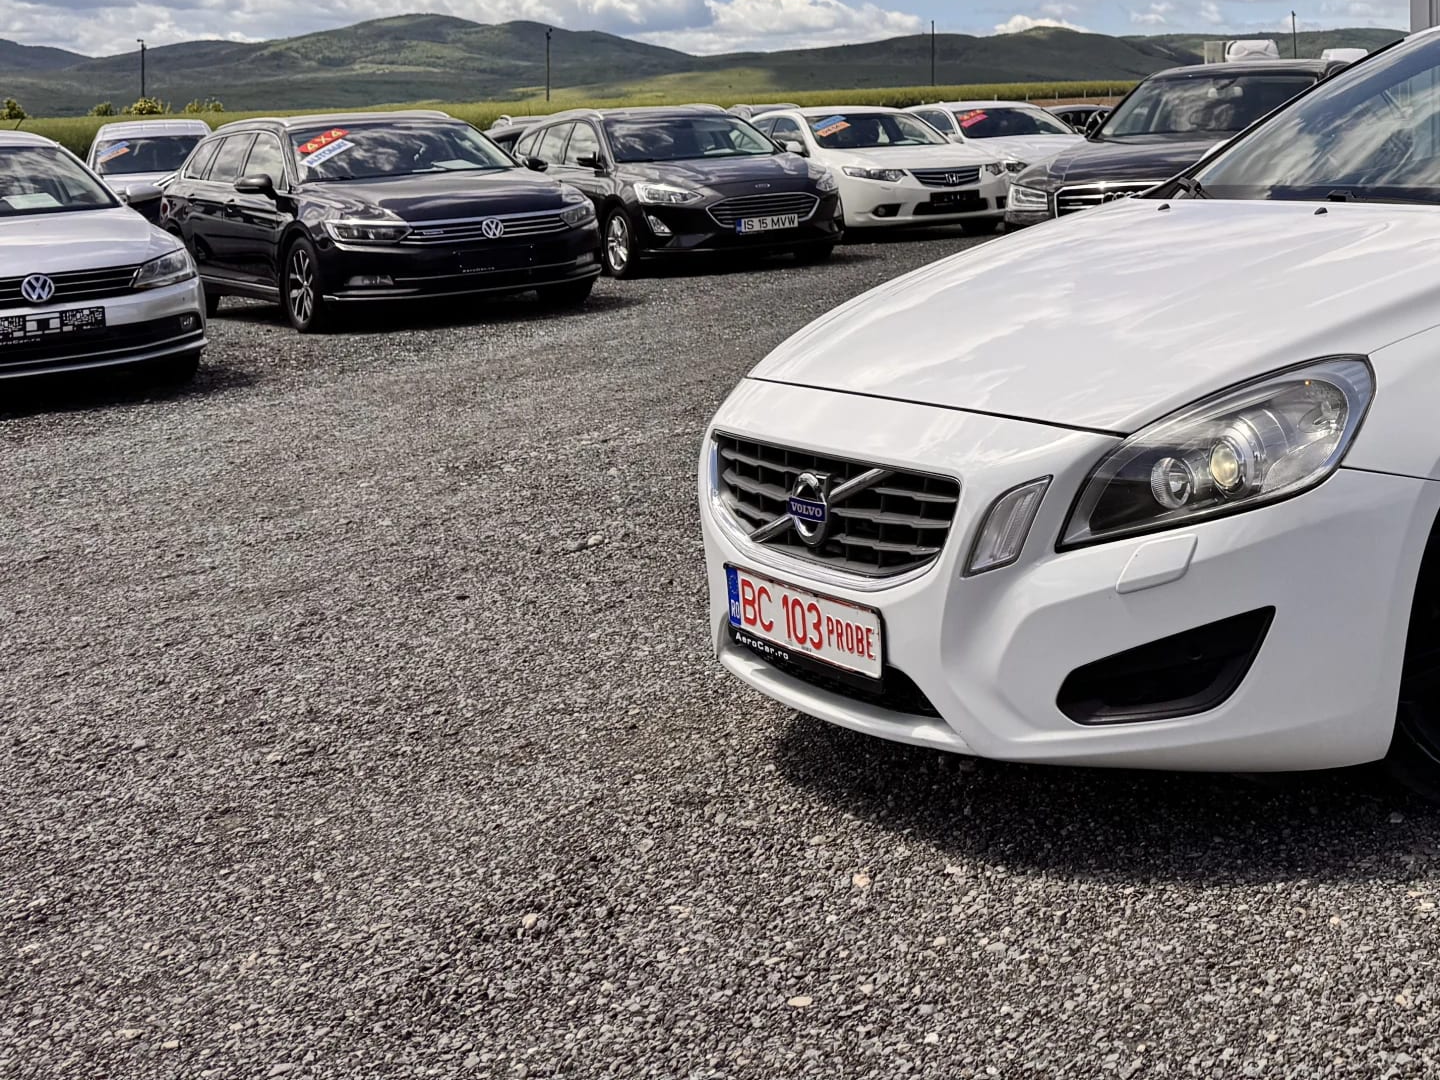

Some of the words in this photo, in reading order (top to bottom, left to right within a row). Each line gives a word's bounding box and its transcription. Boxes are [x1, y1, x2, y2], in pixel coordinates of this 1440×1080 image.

[743, 219, 754, 231] IS
[758, 218, 768, 229] 15
[771, 216, 796, 228] MVW
[790, 501, 823, 517] VOLVO
[730, 599, 741, 619] RO
[741, 578, 774, 633] BC
[782, 593, 824, 650] 103
[826, 615, 876, 661] PROBE
[736, 631, 789, 660] AeroCar.ro
